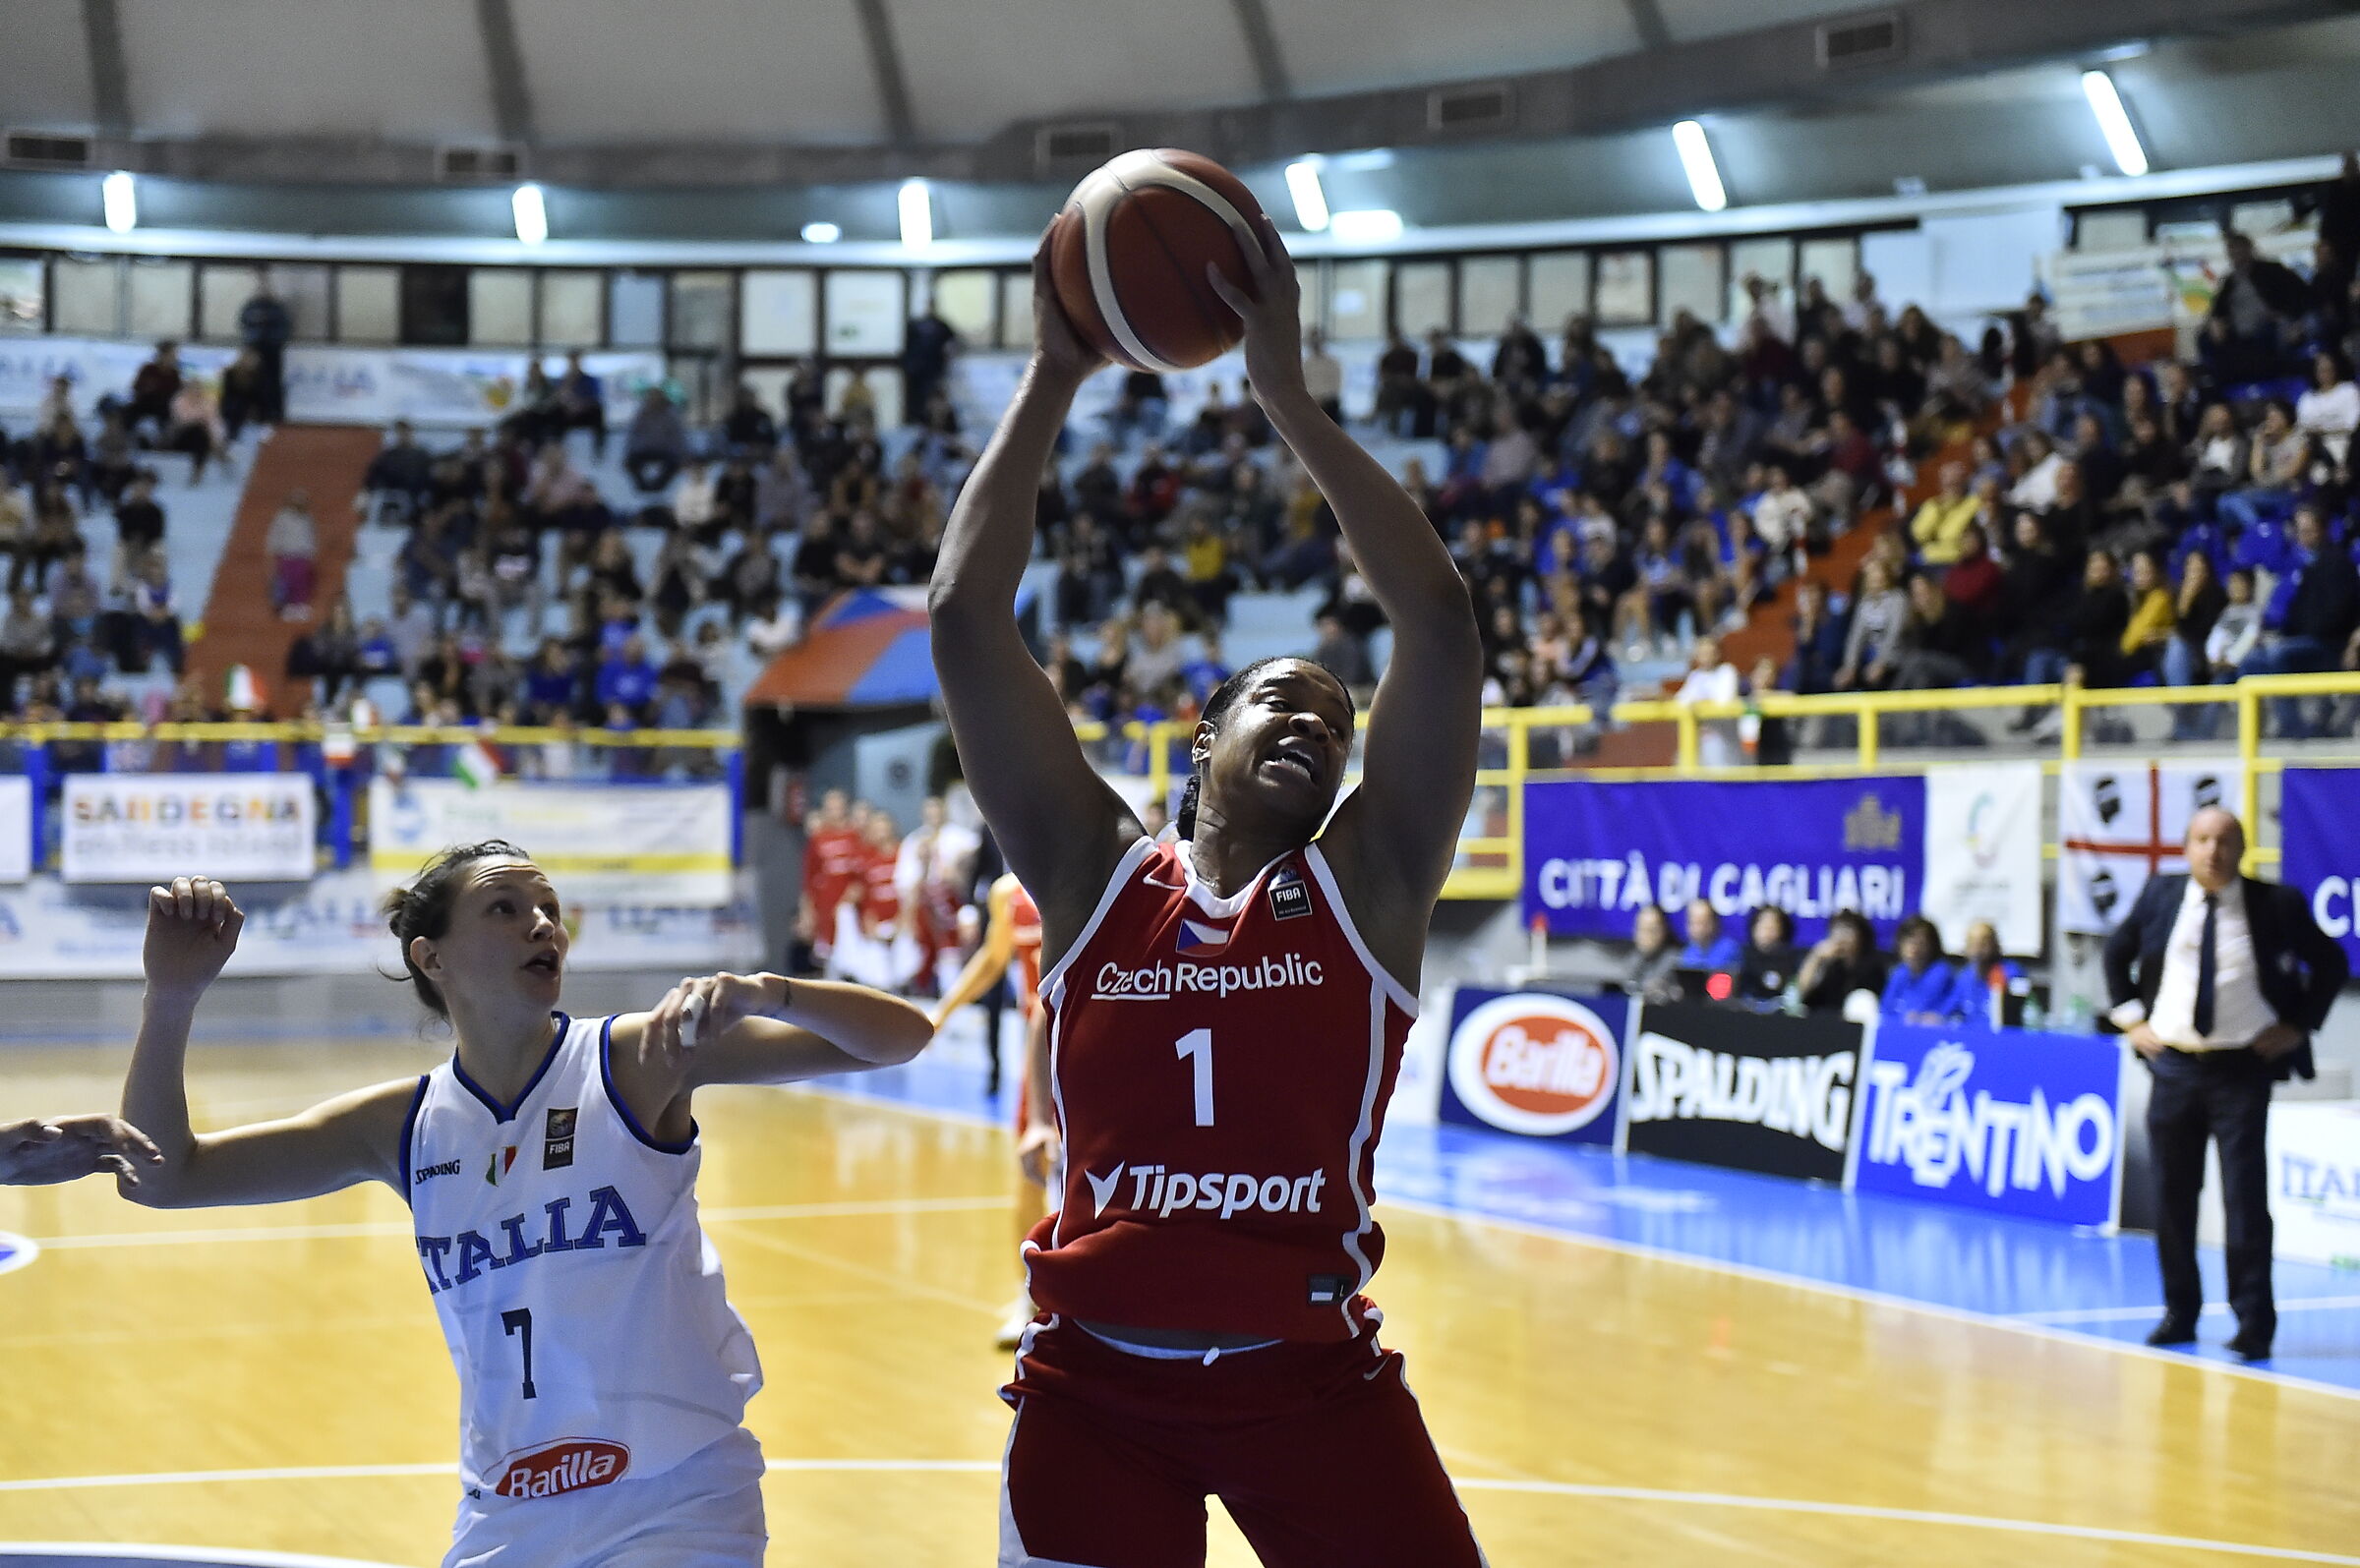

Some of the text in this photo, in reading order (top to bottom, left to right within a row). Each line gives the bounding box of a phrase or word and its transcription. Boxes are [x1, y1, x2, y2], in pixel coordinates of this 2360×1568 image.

[1275, 887, 1301, 902] FIBA
[1538, 849, 1653, 912] CITTÀ
[1658, 861, 1702, 913] DI
[1709, 862, 1906, 920] CAGLIARI
[1175, 953, 1324, 999] Republic
[1175, 1027, 1214, 1127] 1
[1486, 1025, 1605, 1097] Barilla
[1629, 1030, 1857, 1152] SPALDING
[549, 1141, 570, 1155] FIBA
[1868, 1059, 2113, 1199] TRENTINO
[1130, 1165, 1326, 1219] Tipsport
[501, 1307, 537, 1400] 7
[508, 1450, 617, 1499] Barilla
